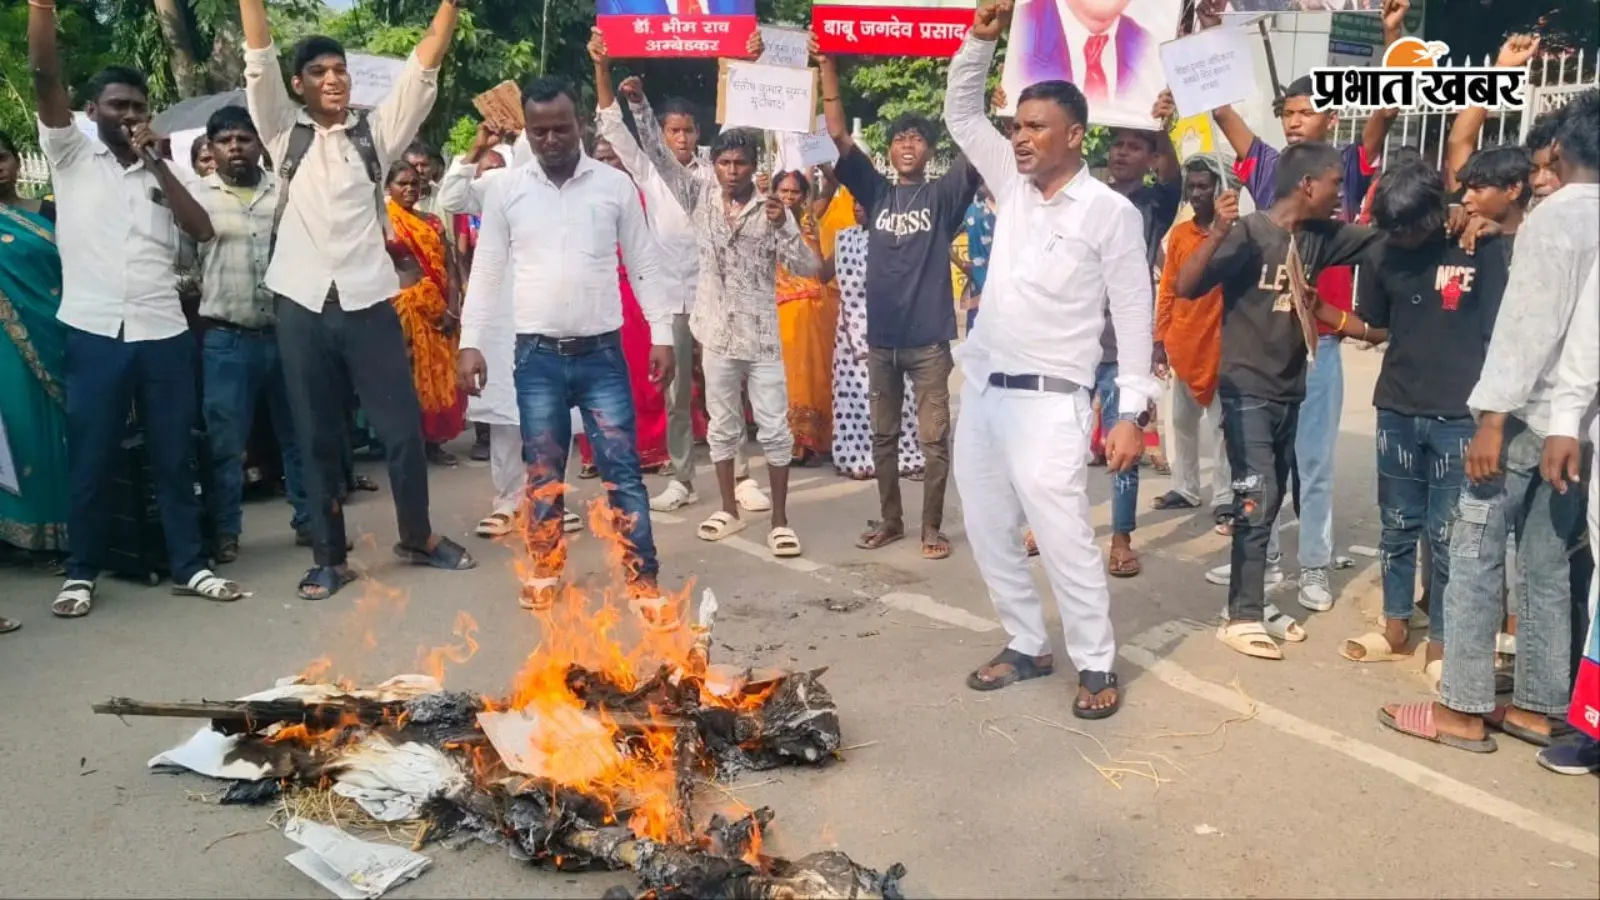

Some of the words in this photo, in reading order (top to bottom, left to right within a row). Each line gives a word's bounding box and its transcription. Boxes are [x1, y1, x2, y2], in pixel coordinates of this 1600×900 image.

[662, 17, 697, 33] भीम
[702, 21, 730, 33] राव
[823, 19, 858, 42] बाबू
[860, 15, 914, 38] जगदेव
[919, 22, 966, 40] प्रसाद
[875, 208, 932, 236] GUESS
[1434, 264, 1476, 292] NICE
